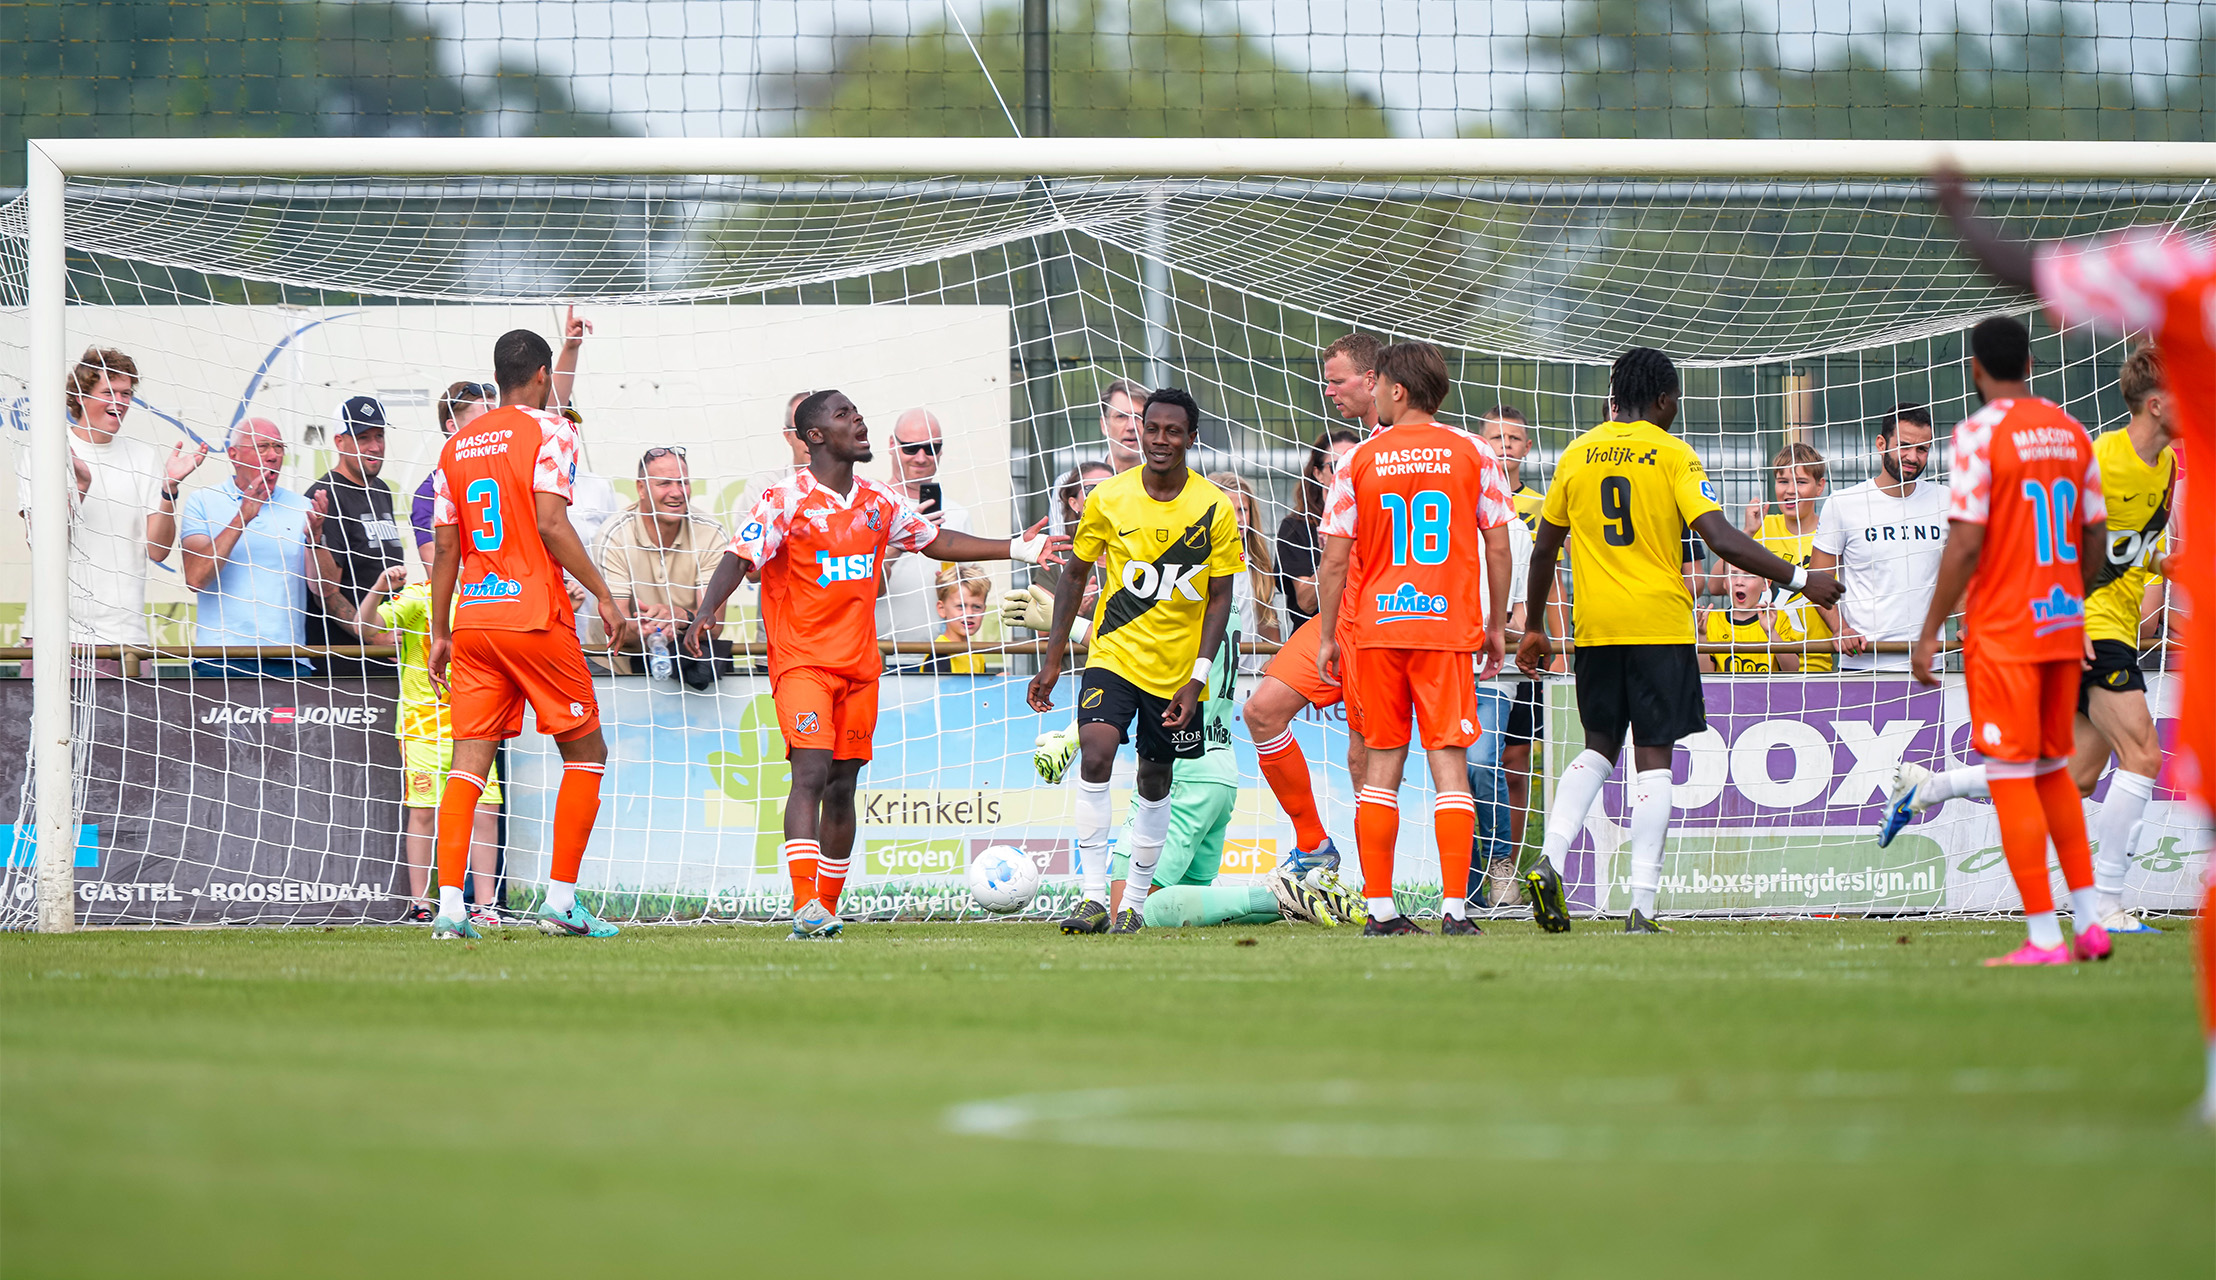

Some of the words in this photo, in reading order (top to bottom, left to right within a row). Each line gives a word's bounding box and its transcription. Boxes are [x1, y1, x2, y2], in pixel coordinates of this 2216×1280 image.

[455, 443, 508, 462] WORKWEAR
[1586, 447, 1636, 466] Vrolijk
[1375, 462, 1451, 477] WORKWEAR
[466, 477, 504, 552] 3
[1600, 475, 1635, 547] 9
[2021, 476, 2079, 566] 10
[1380, 490, 1451, 566] 18
[1865, 525, 1941, 542] GRIND
[463, 579, 522, 597] TIMBO
[1122, 558, 1209, 601] OK
[1376, 595, 1449, 614] TIMBO
[201, 707, 268, 724] JACK
[864, 792, 1001, 825] Krinkels
[878, 845, 954, 868] Groen
[79, 882, 183, 902] GASTEL
[210, 882, 390, 902] ROOSENDAAL
[707, 890, 791, 917] Aanleg
[849, 888, 988, 918] sportvelde
